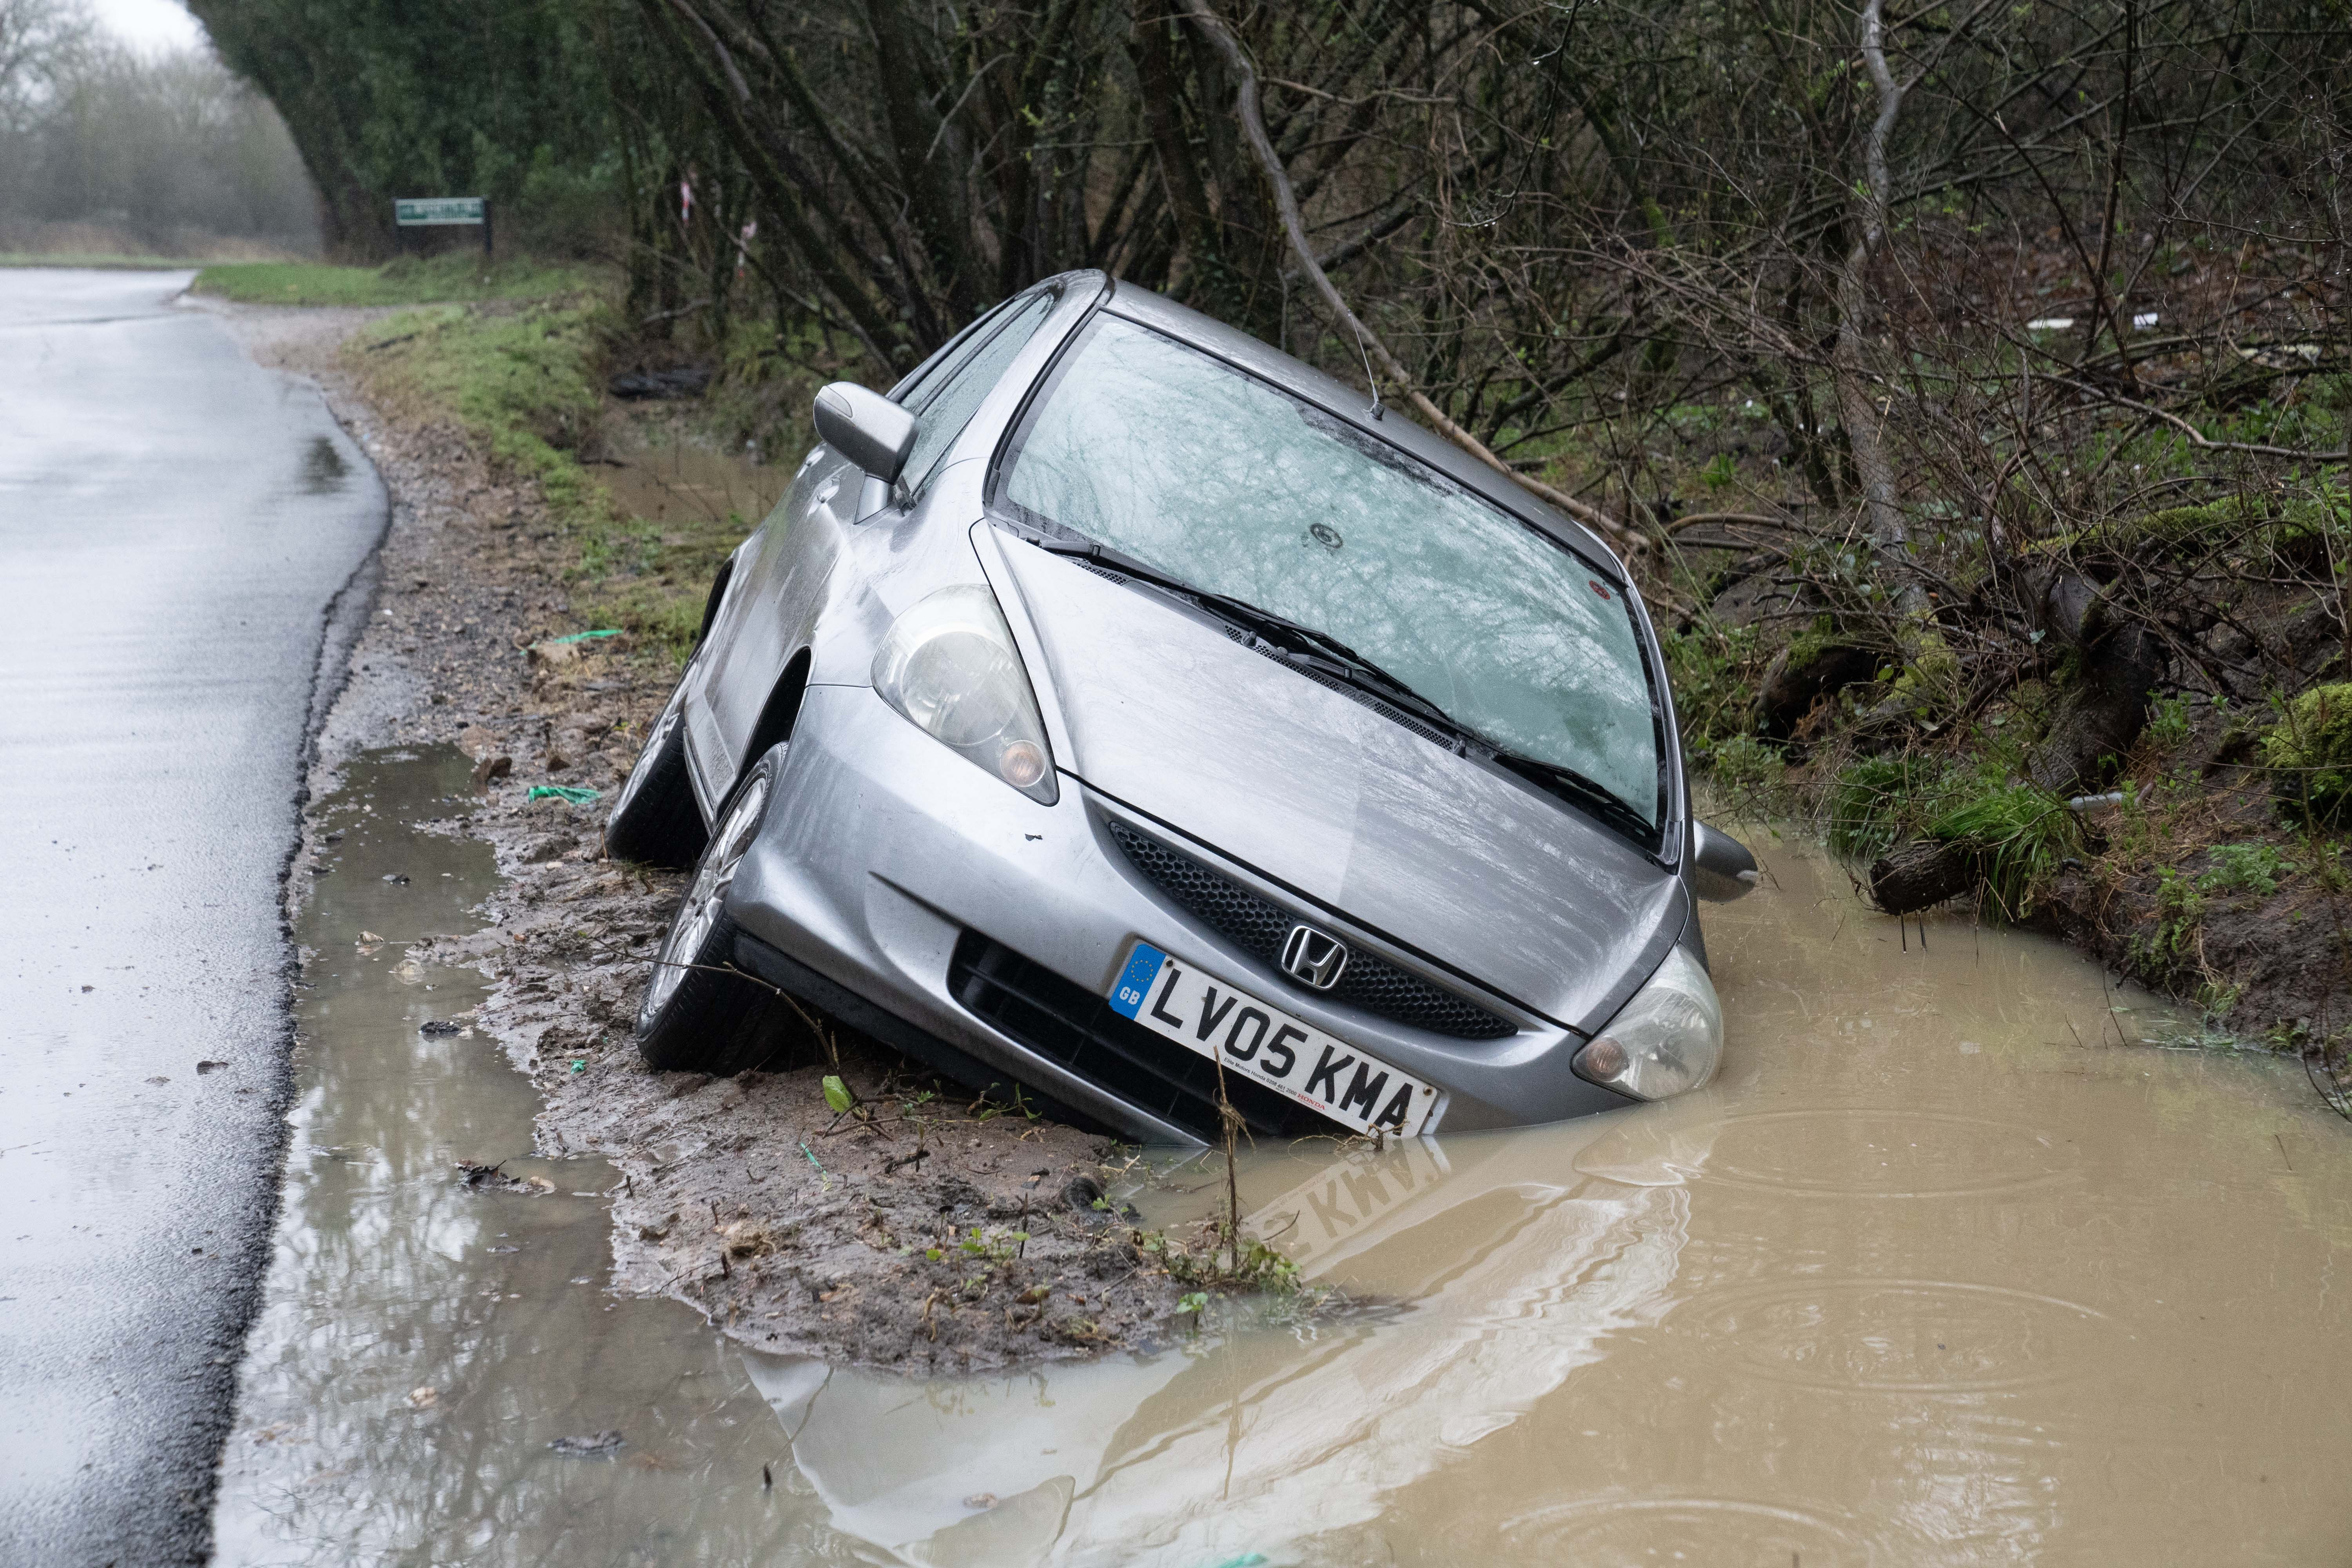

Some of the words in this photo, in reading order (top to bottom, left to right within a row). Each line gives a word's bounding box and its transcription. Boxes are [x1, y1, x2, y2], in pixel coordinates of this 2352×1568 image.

[1120, 986, 1140, 1005] GB
[1150, 968, 1308, 1078] LV05
[1304, 1044, 1413, 1136] KMA
[1235, 1063, 1250, 1073] Motors
[1251, 1071, 1266, 1081] Honda
[1286, 1088, 1297, 1096] 2000
[1297, 1093, 1325, 1111] HONDA
